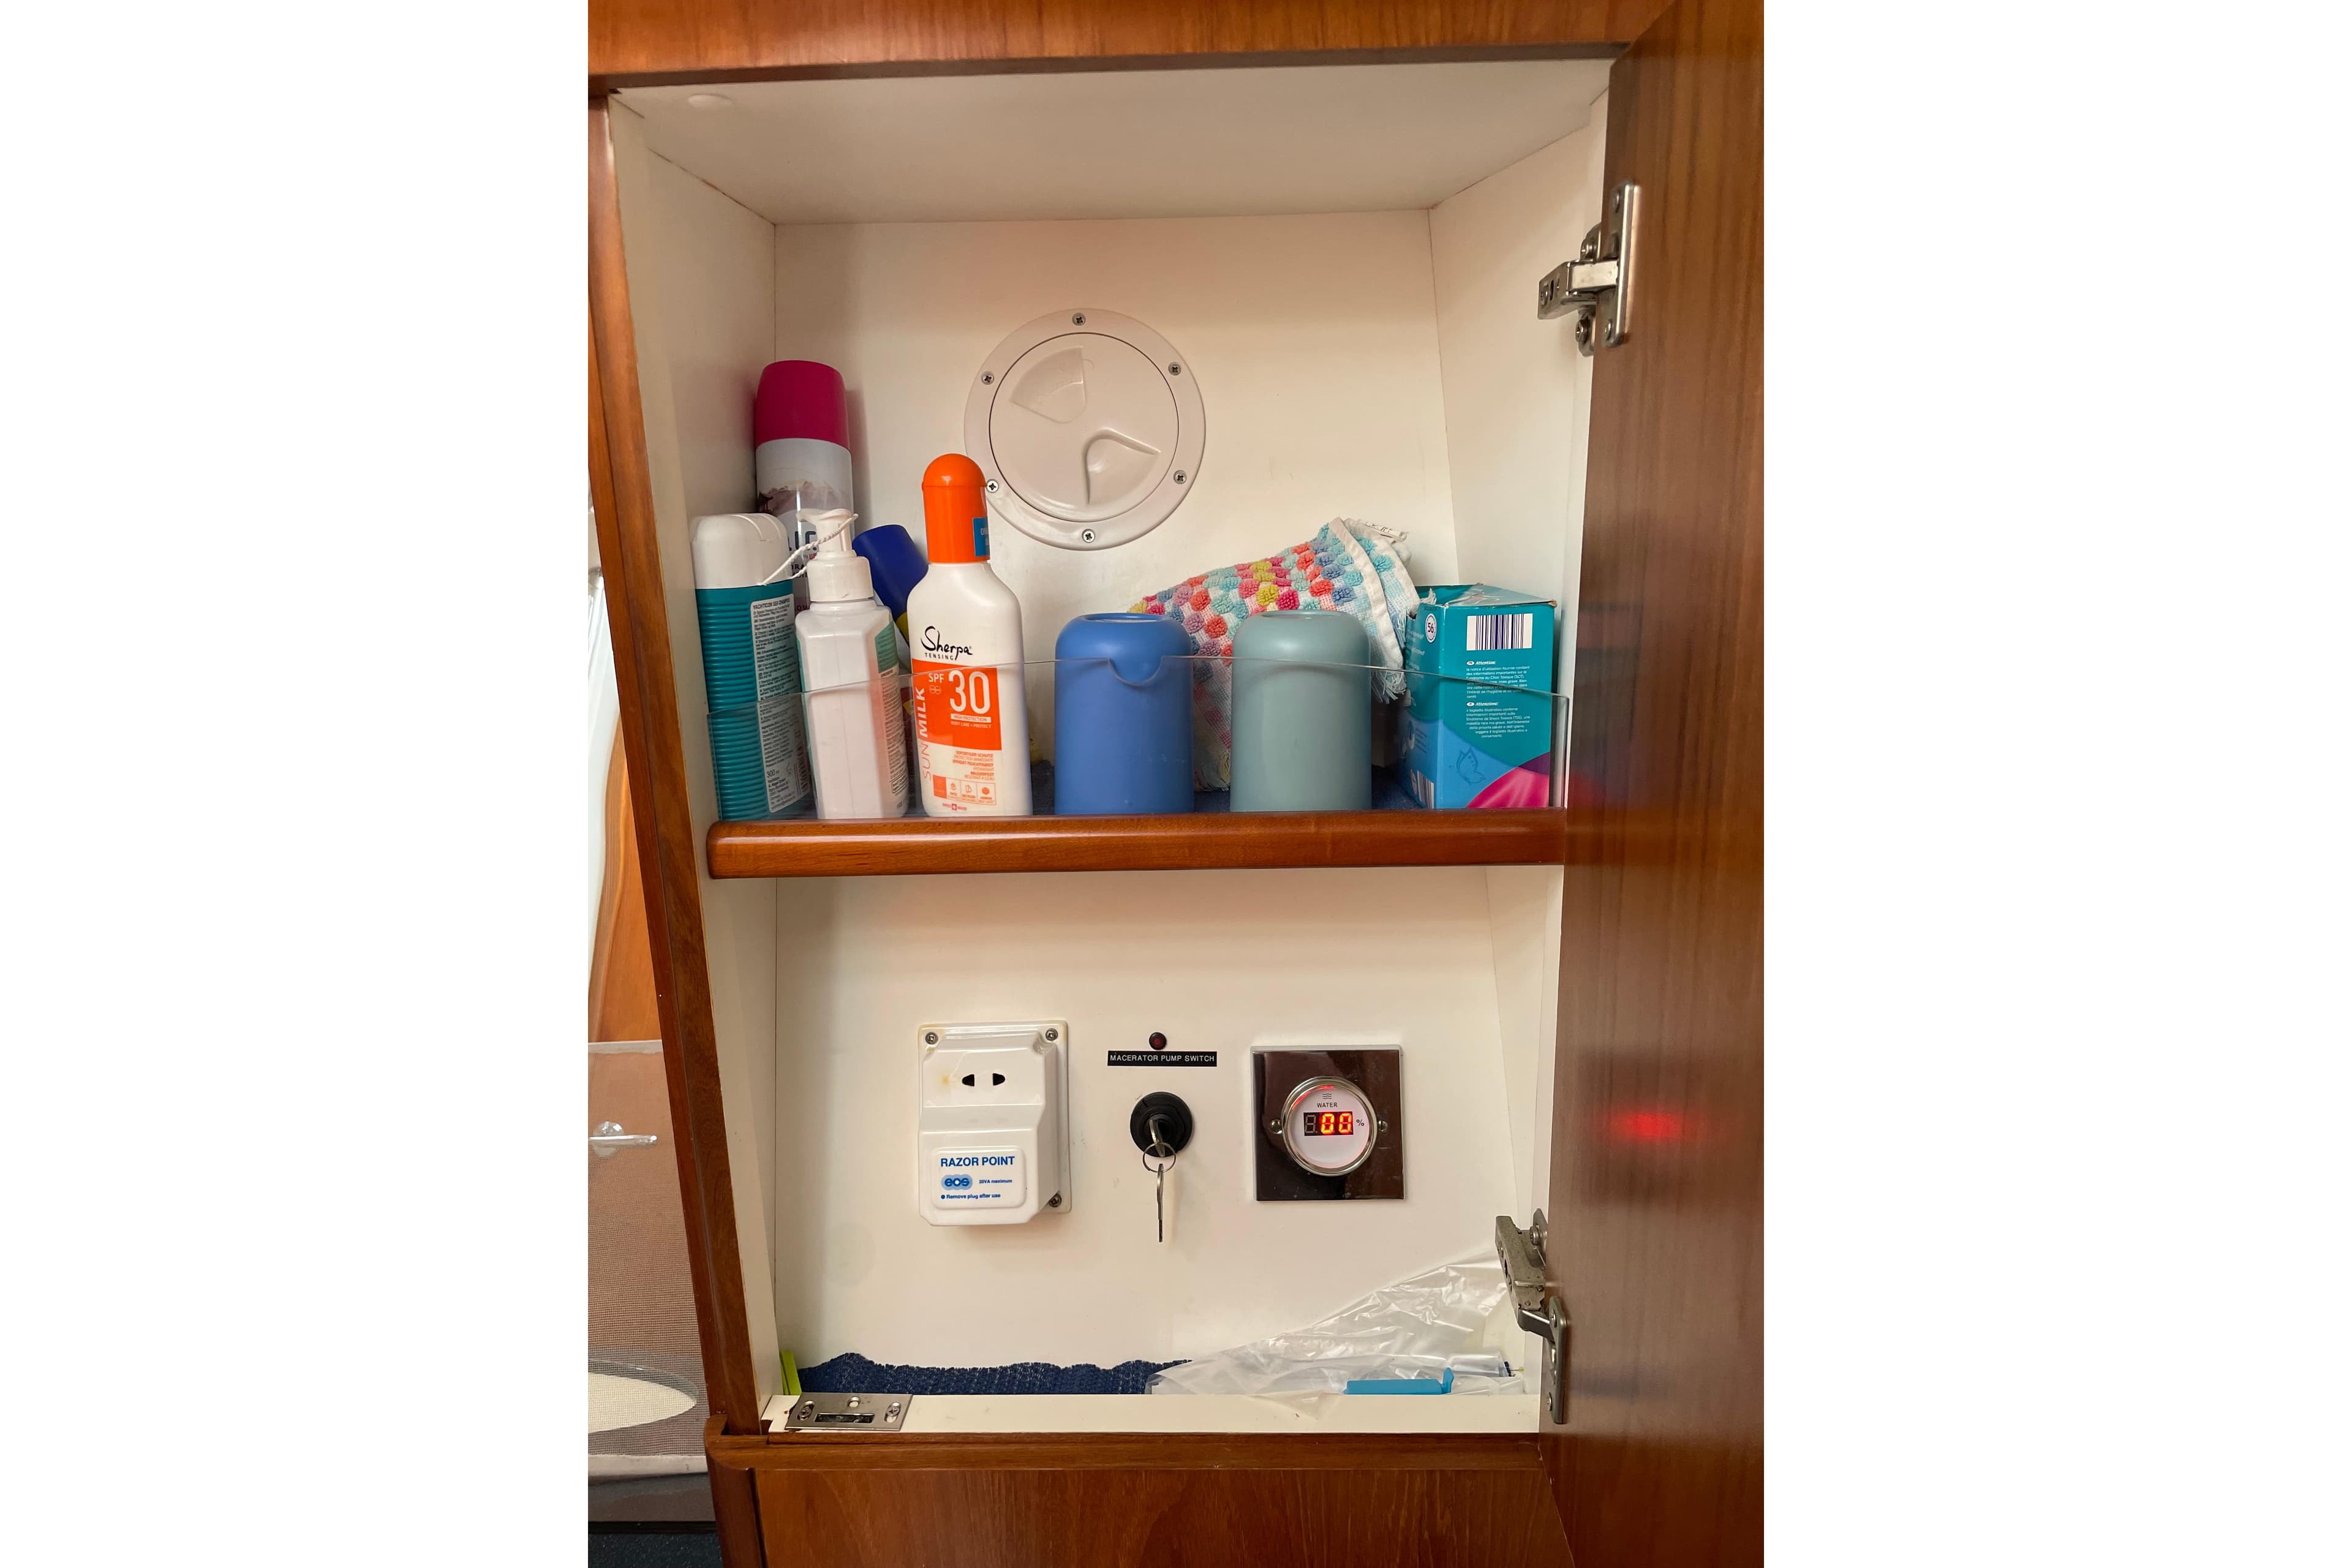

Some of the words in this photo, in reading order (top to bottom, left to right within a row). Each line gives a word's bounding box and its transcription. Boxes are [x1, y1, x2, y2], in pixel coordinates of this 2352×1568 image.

[921, 626, 973, 660] Sherpa
[1428, 622, 1433, 633] 56
[929, 673, 944, 684] SPF
[948, 670, 990, 714] 30
[916, 687, 928, 738] MILK
[921, 742, 931, 781] SUN
[941, 1157, 979, 1167] RAZOR
[982, 1156, 1015, 1166] POINT
